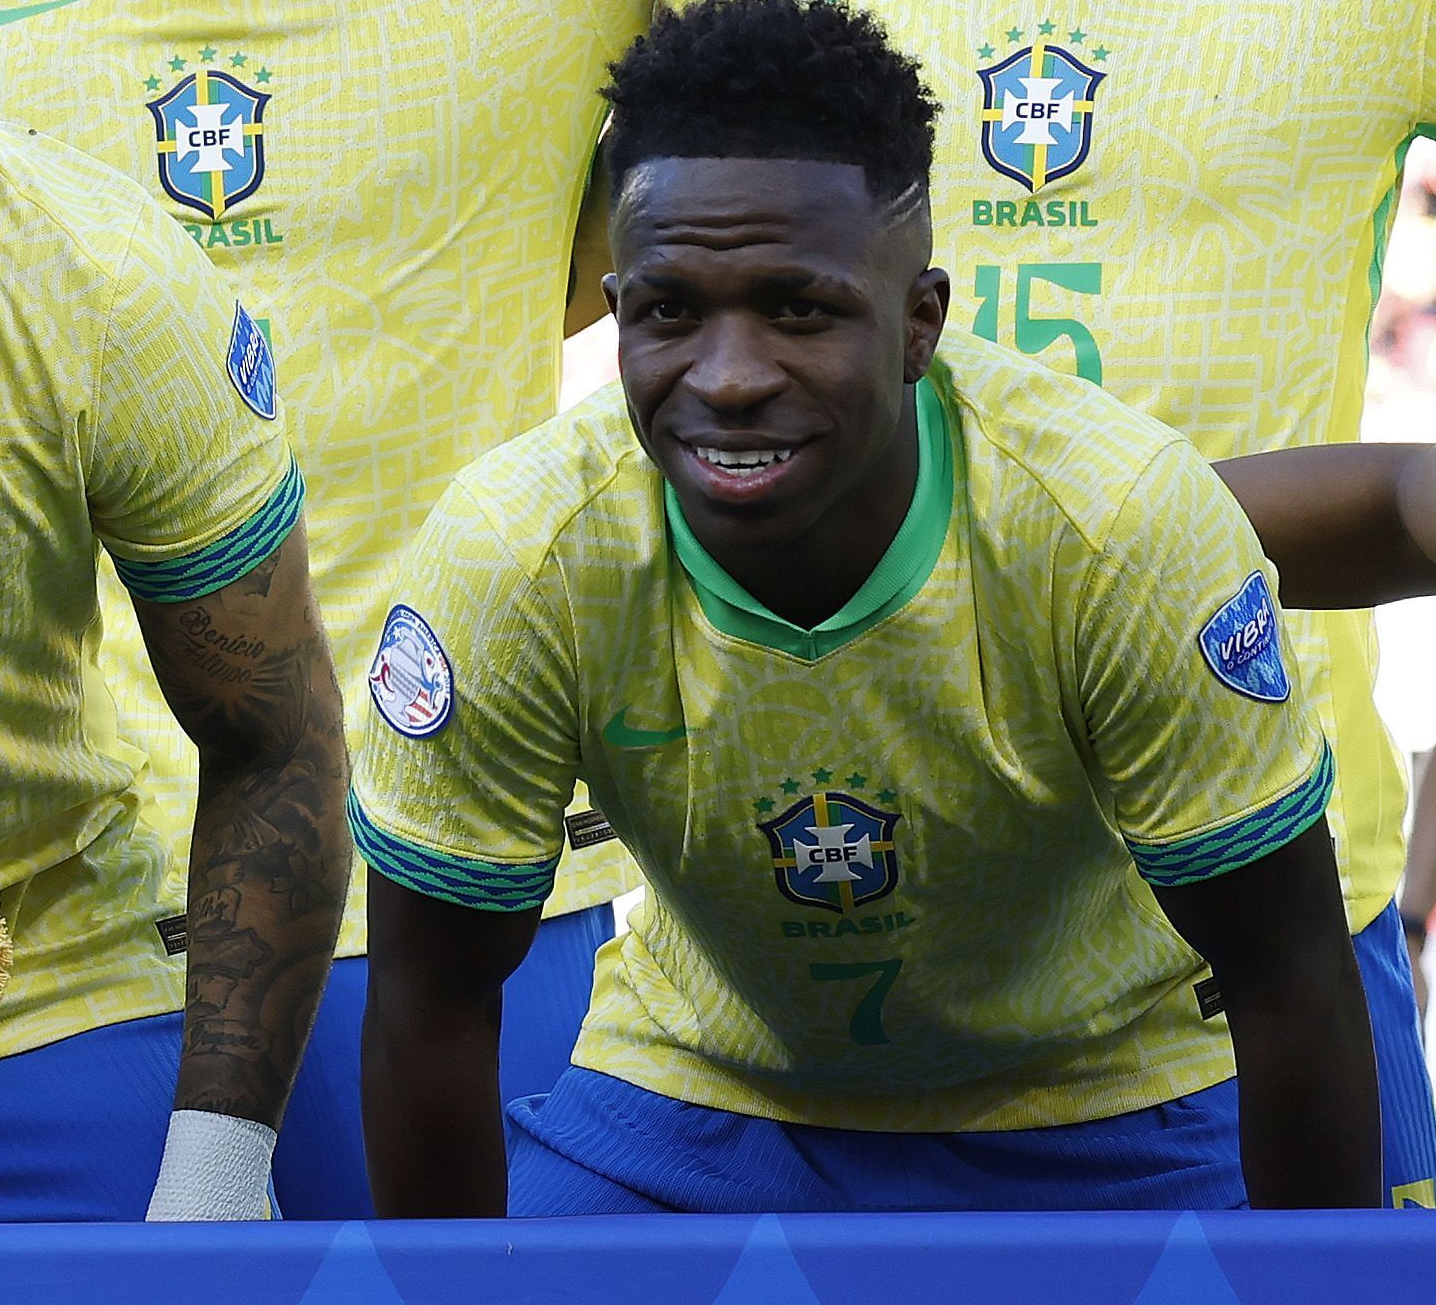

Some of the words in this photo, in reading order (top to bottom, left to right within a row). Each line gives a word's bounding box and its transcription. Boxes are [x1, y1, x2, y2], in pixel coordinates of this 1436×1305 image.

[1014, 101, 1061, 121] CBF
[188, 128, 231, 148] CBF
[973, 199, 1099, 228] BRASIL
[183, 218, 284, 249] RASIL
[1220, 598, 1270, 661] VIBRA
[808, 844, 859, 866] CBF
[781, 910, 919, 939] BRASIL
[809, 958, 904, 1046] 7
